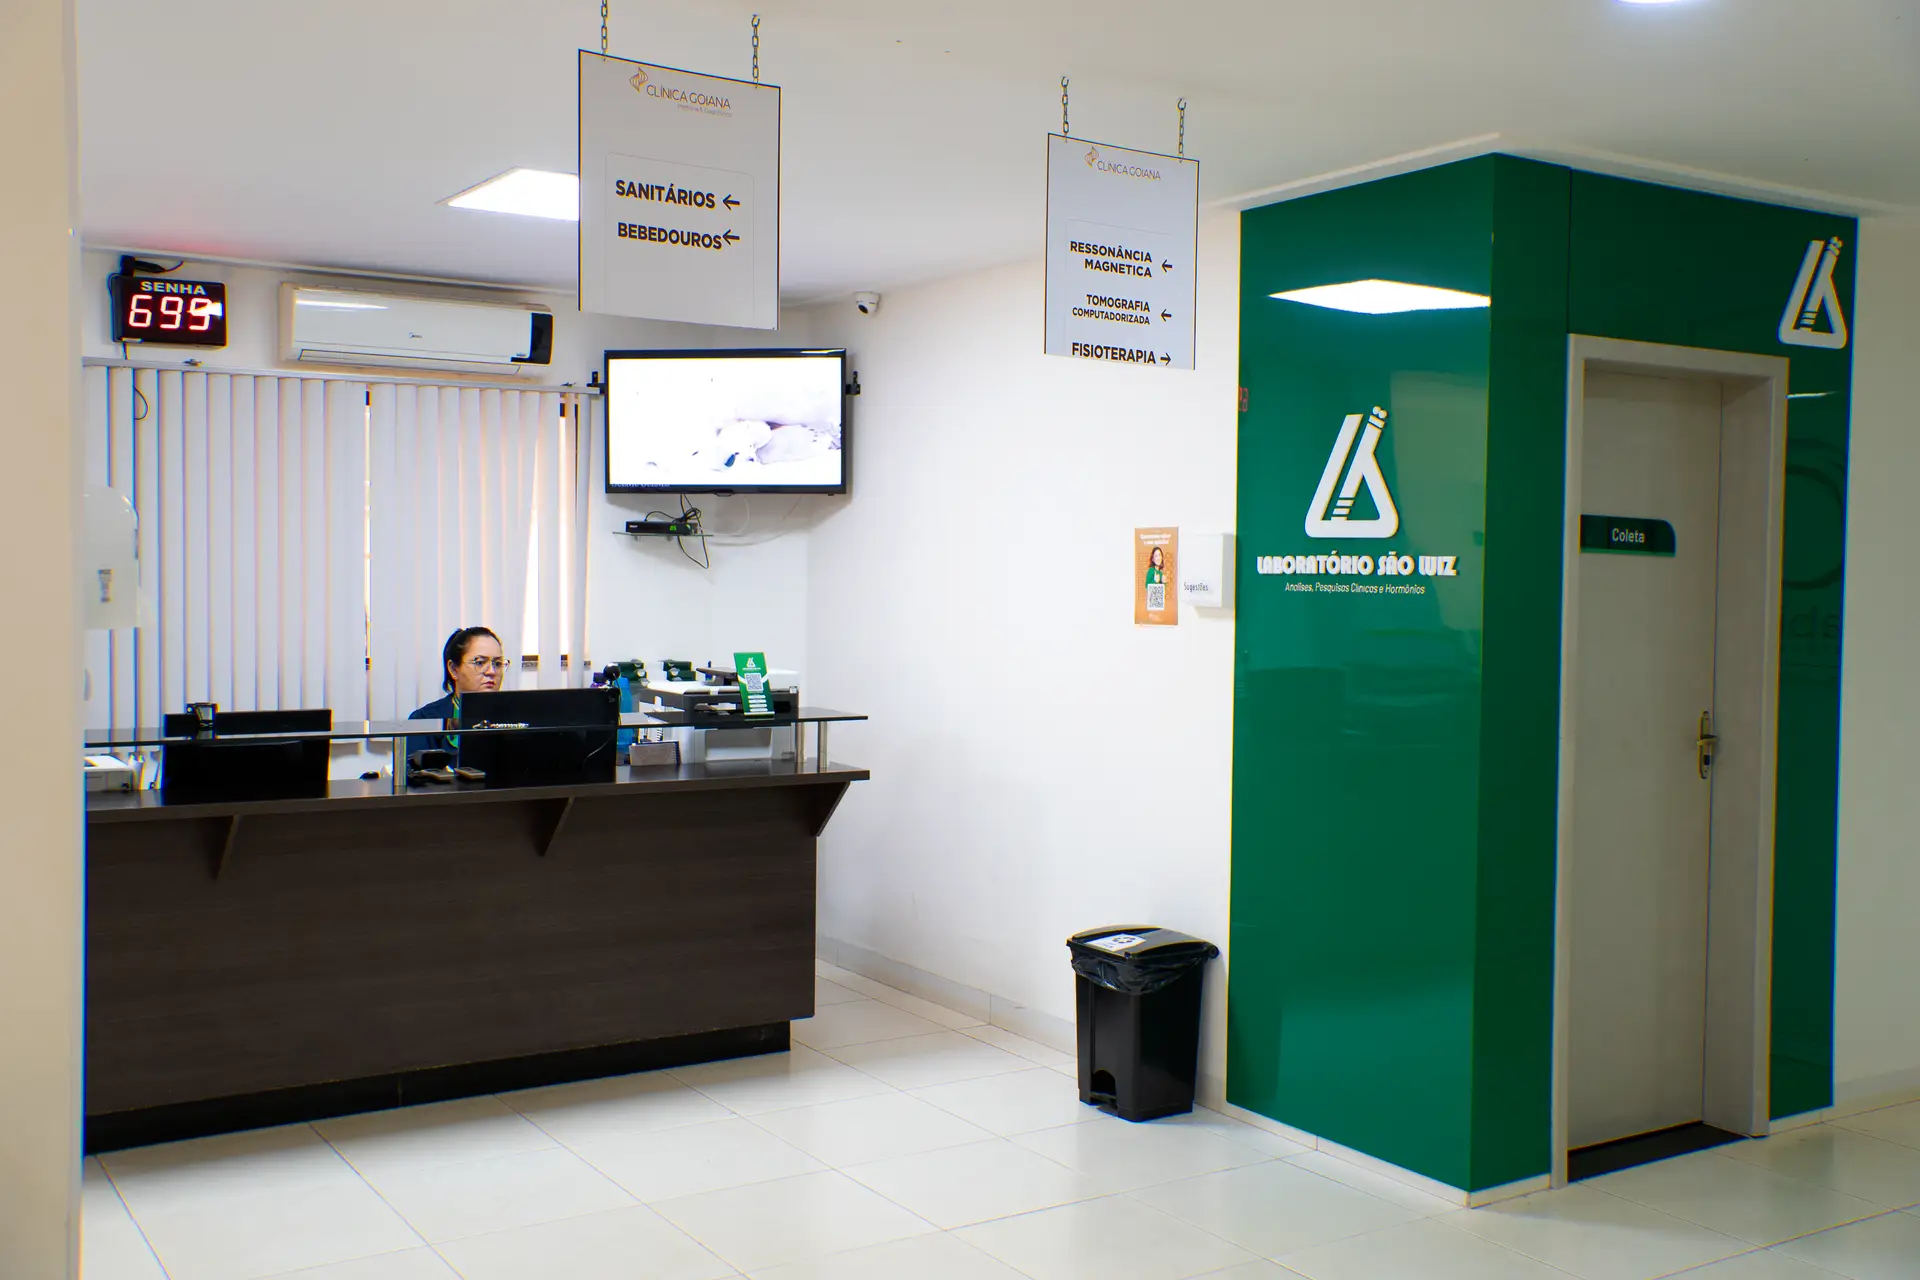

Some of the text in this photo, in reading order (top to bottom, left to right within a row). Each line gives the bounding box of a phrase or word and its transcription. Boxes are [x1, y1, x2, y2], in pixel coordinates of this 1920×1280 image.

[646, 83, 689, 103] CLÍNICA
[689, 92, 731, 110] GOIANA
[1097, 159, 1161, 182] CLÍNICA GOIANA
[615, 179, 716, 209] SANITÁRIOS
[617, 221, 723, 250] BEBEDOUROS
[1070, 240, 1153, 263] RESSONÂNCIA
[1084, 258, 1153, 278] MAGNETICA
[140, 281, 207, 296] SENHA
[1086, 293, 1151, 313] TOMOGRAFIA
[1072, 306, 1151, 326] COMPUTADORIZADA
[1071, 342, 1157, 366] FISIOTERAPIA
[1611, 527, 1646, 544] Coleta
[1256, 550, 1458, 576] LABORATÓRIO SÃO LUIZ
[1183, 581, 1209, 593] Sugestões
[1315, 581, 1350, 594] Pesquisas
[1379, 585, 1384, 594] e
